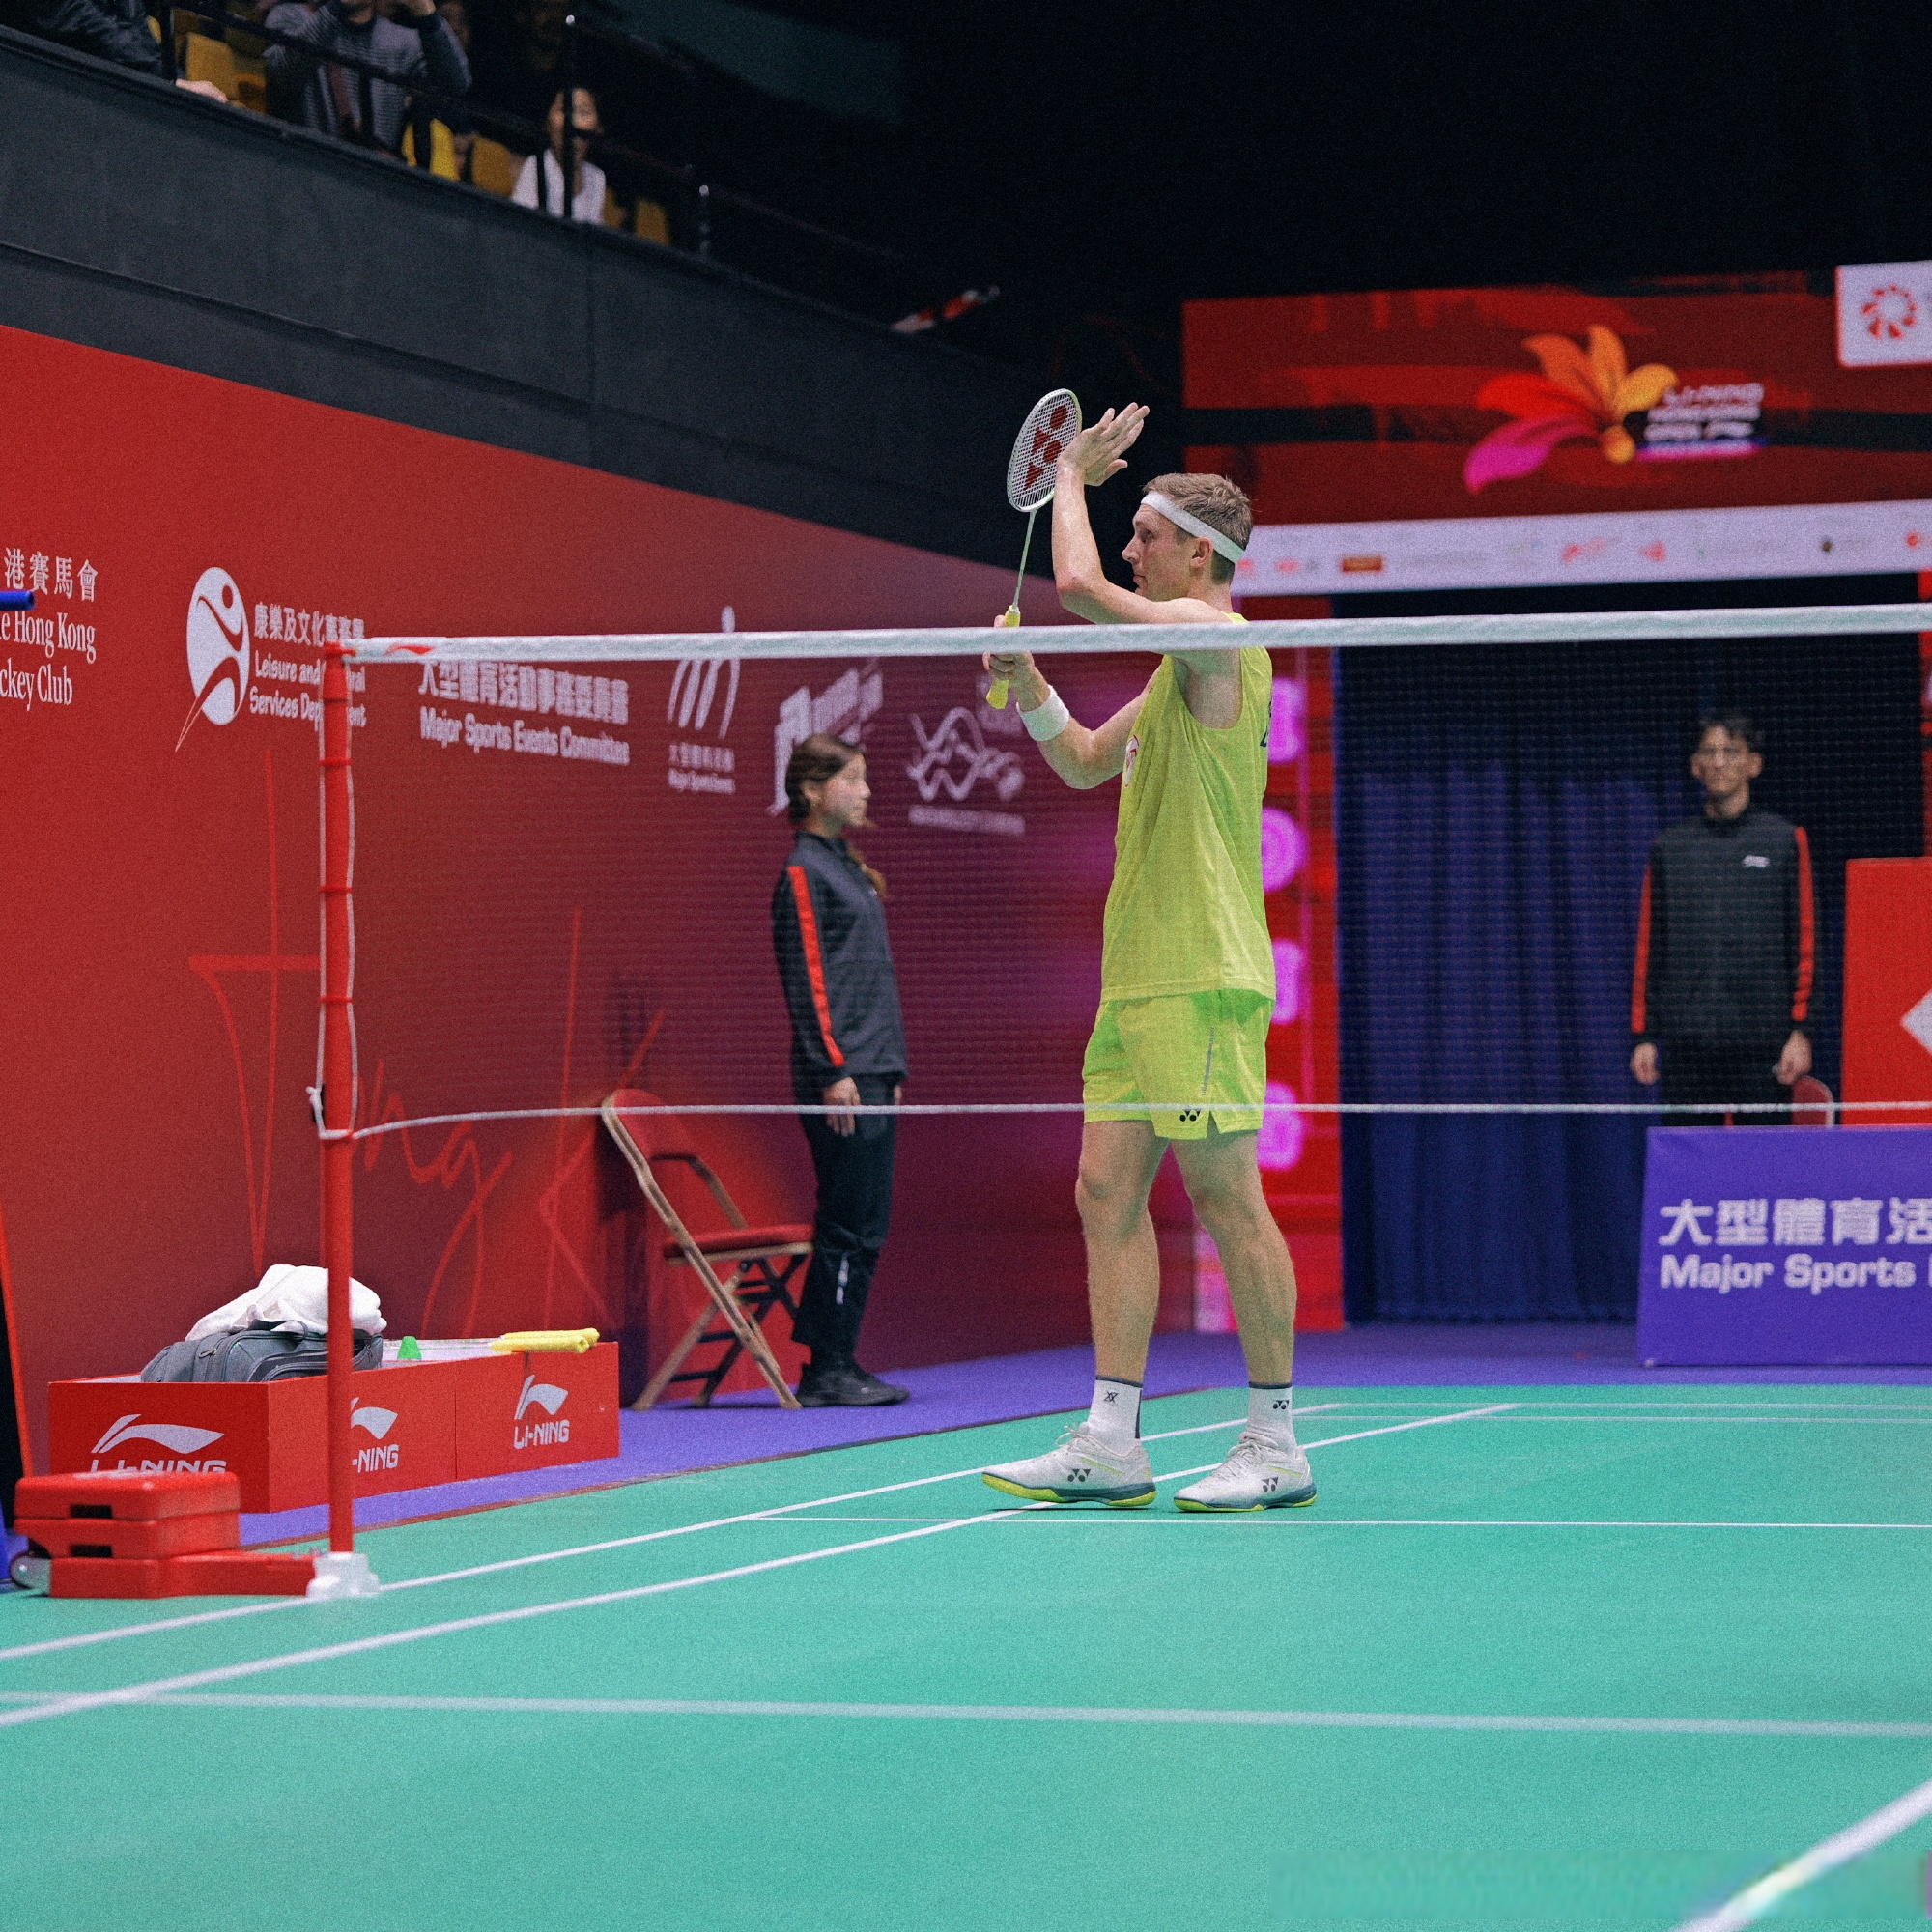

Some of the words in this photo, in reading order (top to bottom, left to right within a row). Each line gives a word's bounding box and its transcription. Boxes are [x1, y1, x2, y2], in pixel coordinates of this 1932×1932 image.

[4, 547, 98, 602] 港賽馬會
[14, 611, 54, 658] Hong
[57, 612, 96, 664] Kong
[37, 663, 72, 705] Club
[255, 649, 298, 682] Leisure
[298, 659, 321, 685] and
[250, 686, 298, 719] Services
[419, 706, 462, 748] Major
[465, 712, 512, 753] Sports
[513, 719, 558, 756] Events
[1661, 1254, 1775, 1294] Major
[1784, 1253, 1917, 1295] Sports
[514, 1419, 570, 1449] LI-NING
[352, 1444, 400, 1474] -NING
